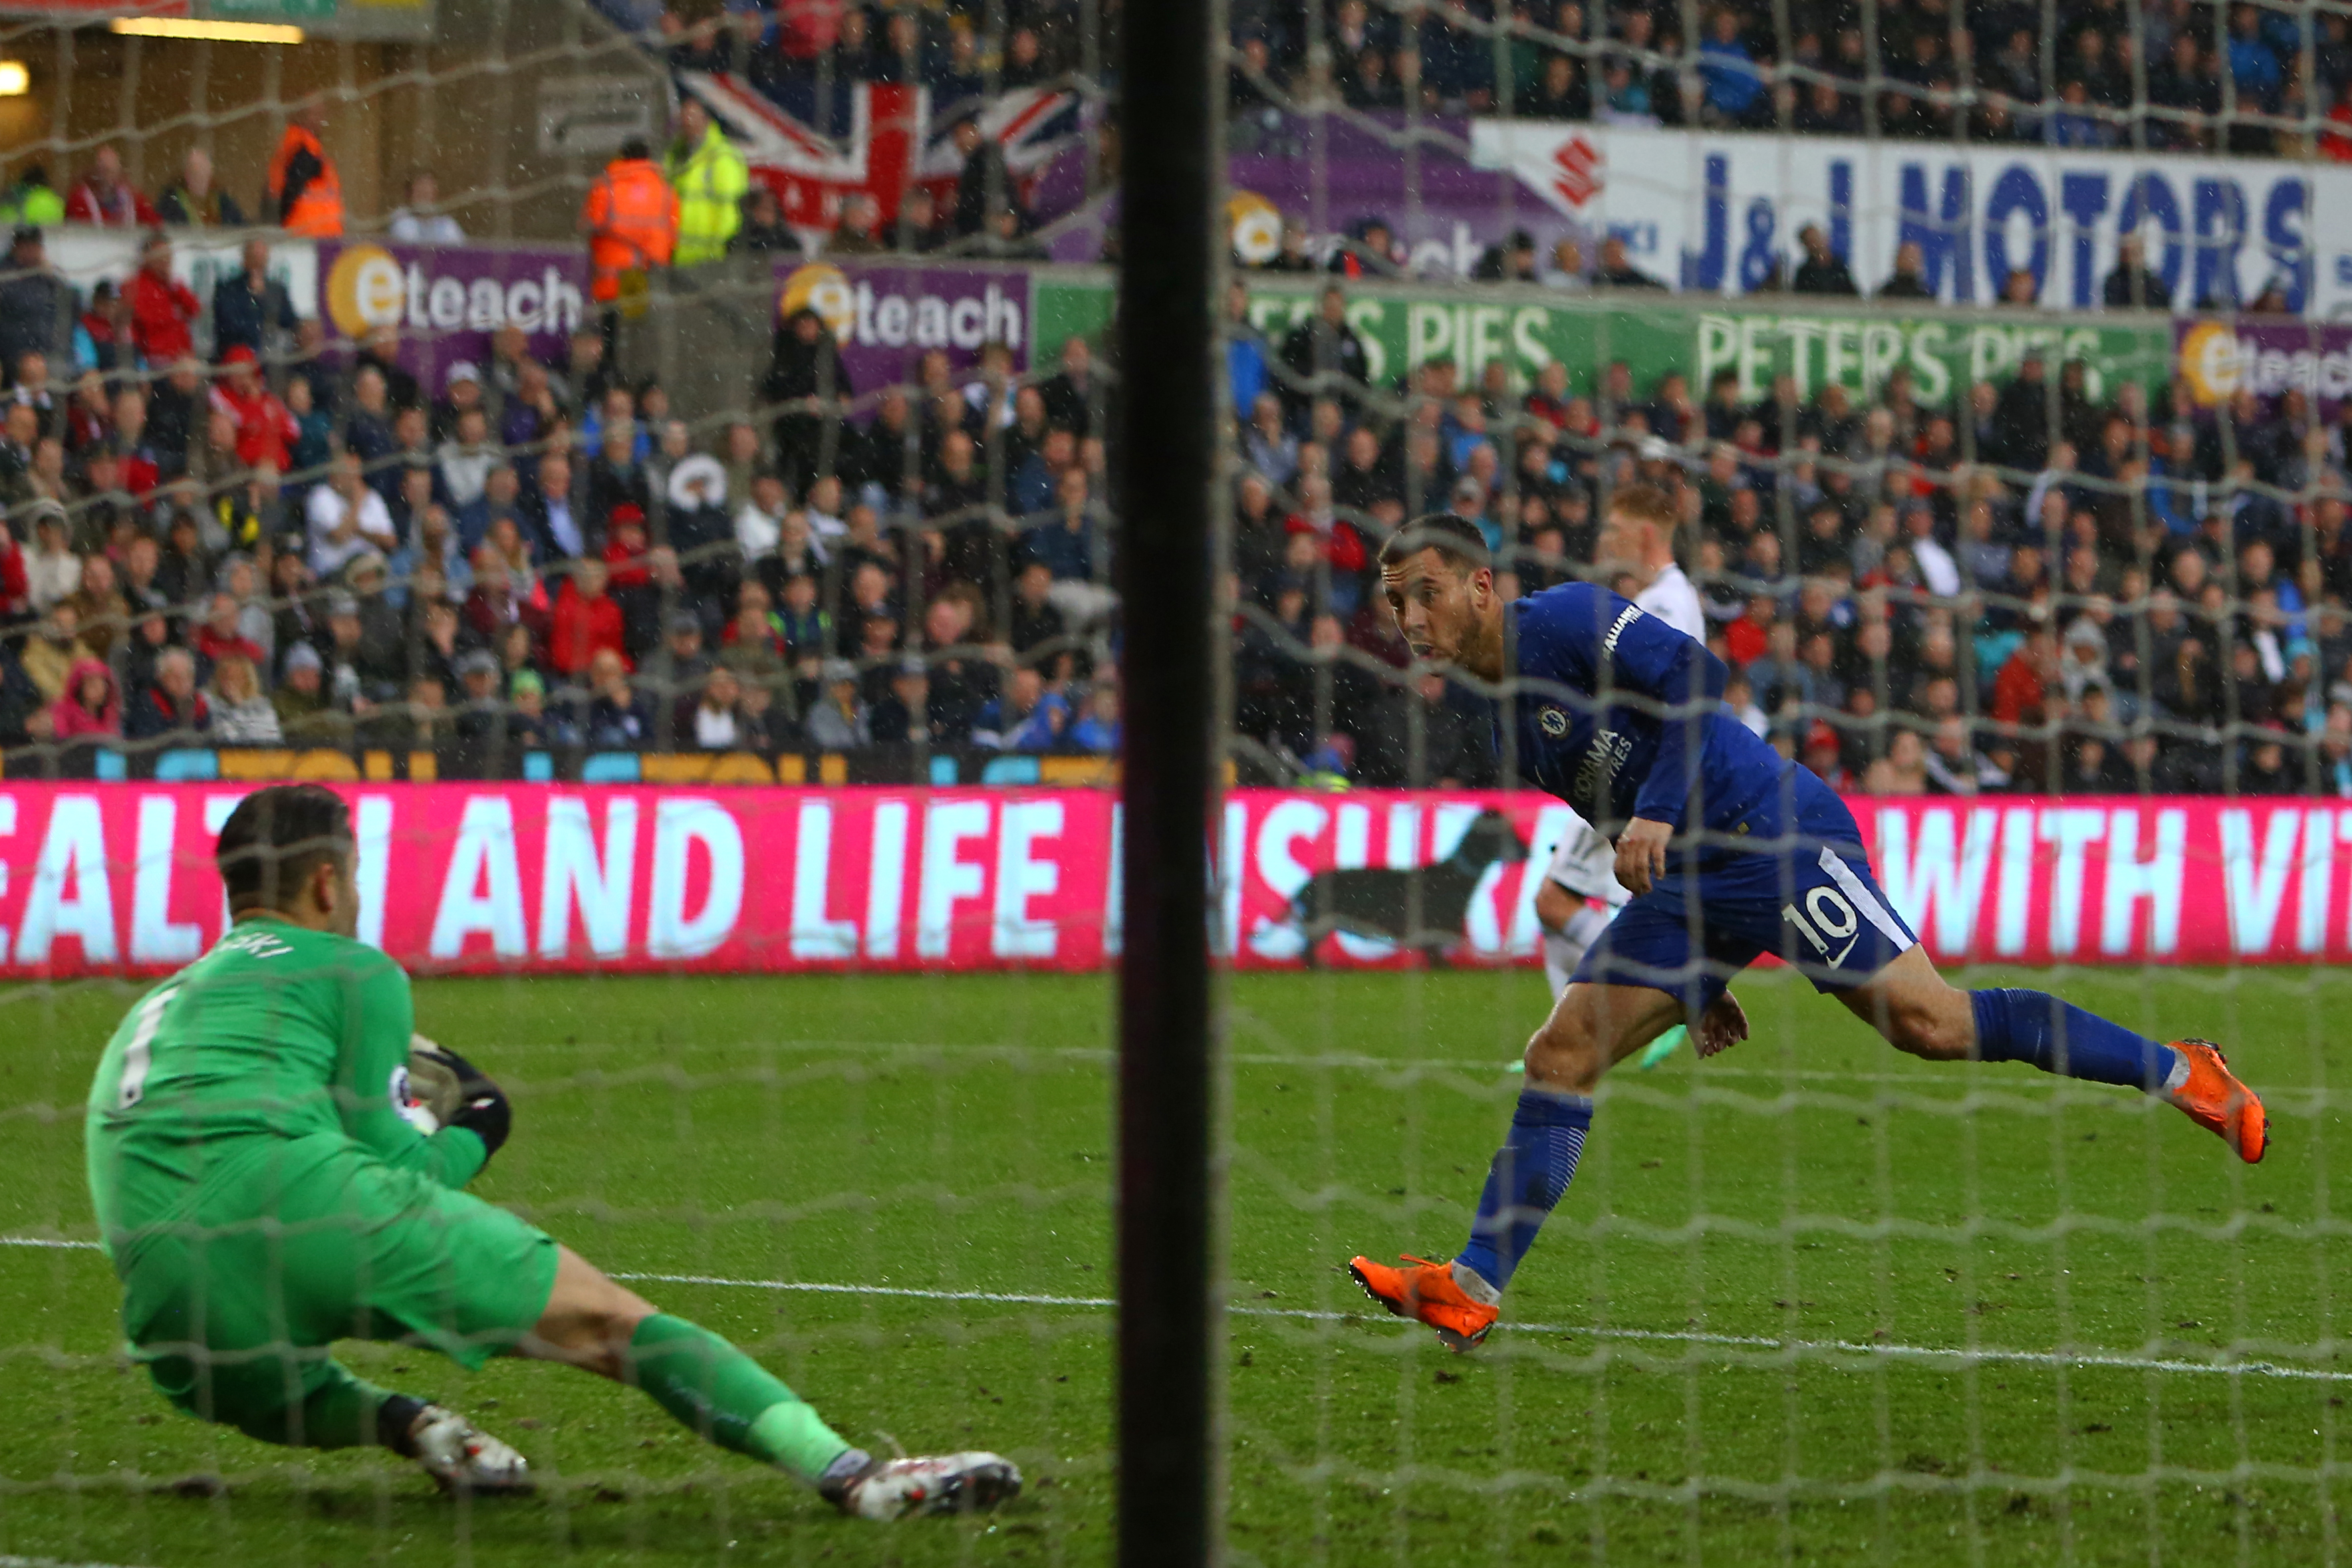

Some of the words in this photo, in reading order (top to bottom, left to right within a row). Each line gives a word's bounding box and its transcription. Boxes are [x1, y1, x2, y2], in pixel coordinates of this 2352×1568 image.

[1900, 160, 2314, 316] MOTORS
[355, 257, 583, 334] eteach
[809, 279, 1022, 349] eteach
[1407, 303, 1553, 396] PIES
[2201, 332, 2352, 399] eteac
[429, 796, 745, 958] AND
[789, 798, 1064, 958] LIFE
[1876, 807, 2187, 956] WITH
[2218, 807, 2352, 955] VI
[1781, 886, 1858, 956] 10
[118, 984, 181, 1111] 1
